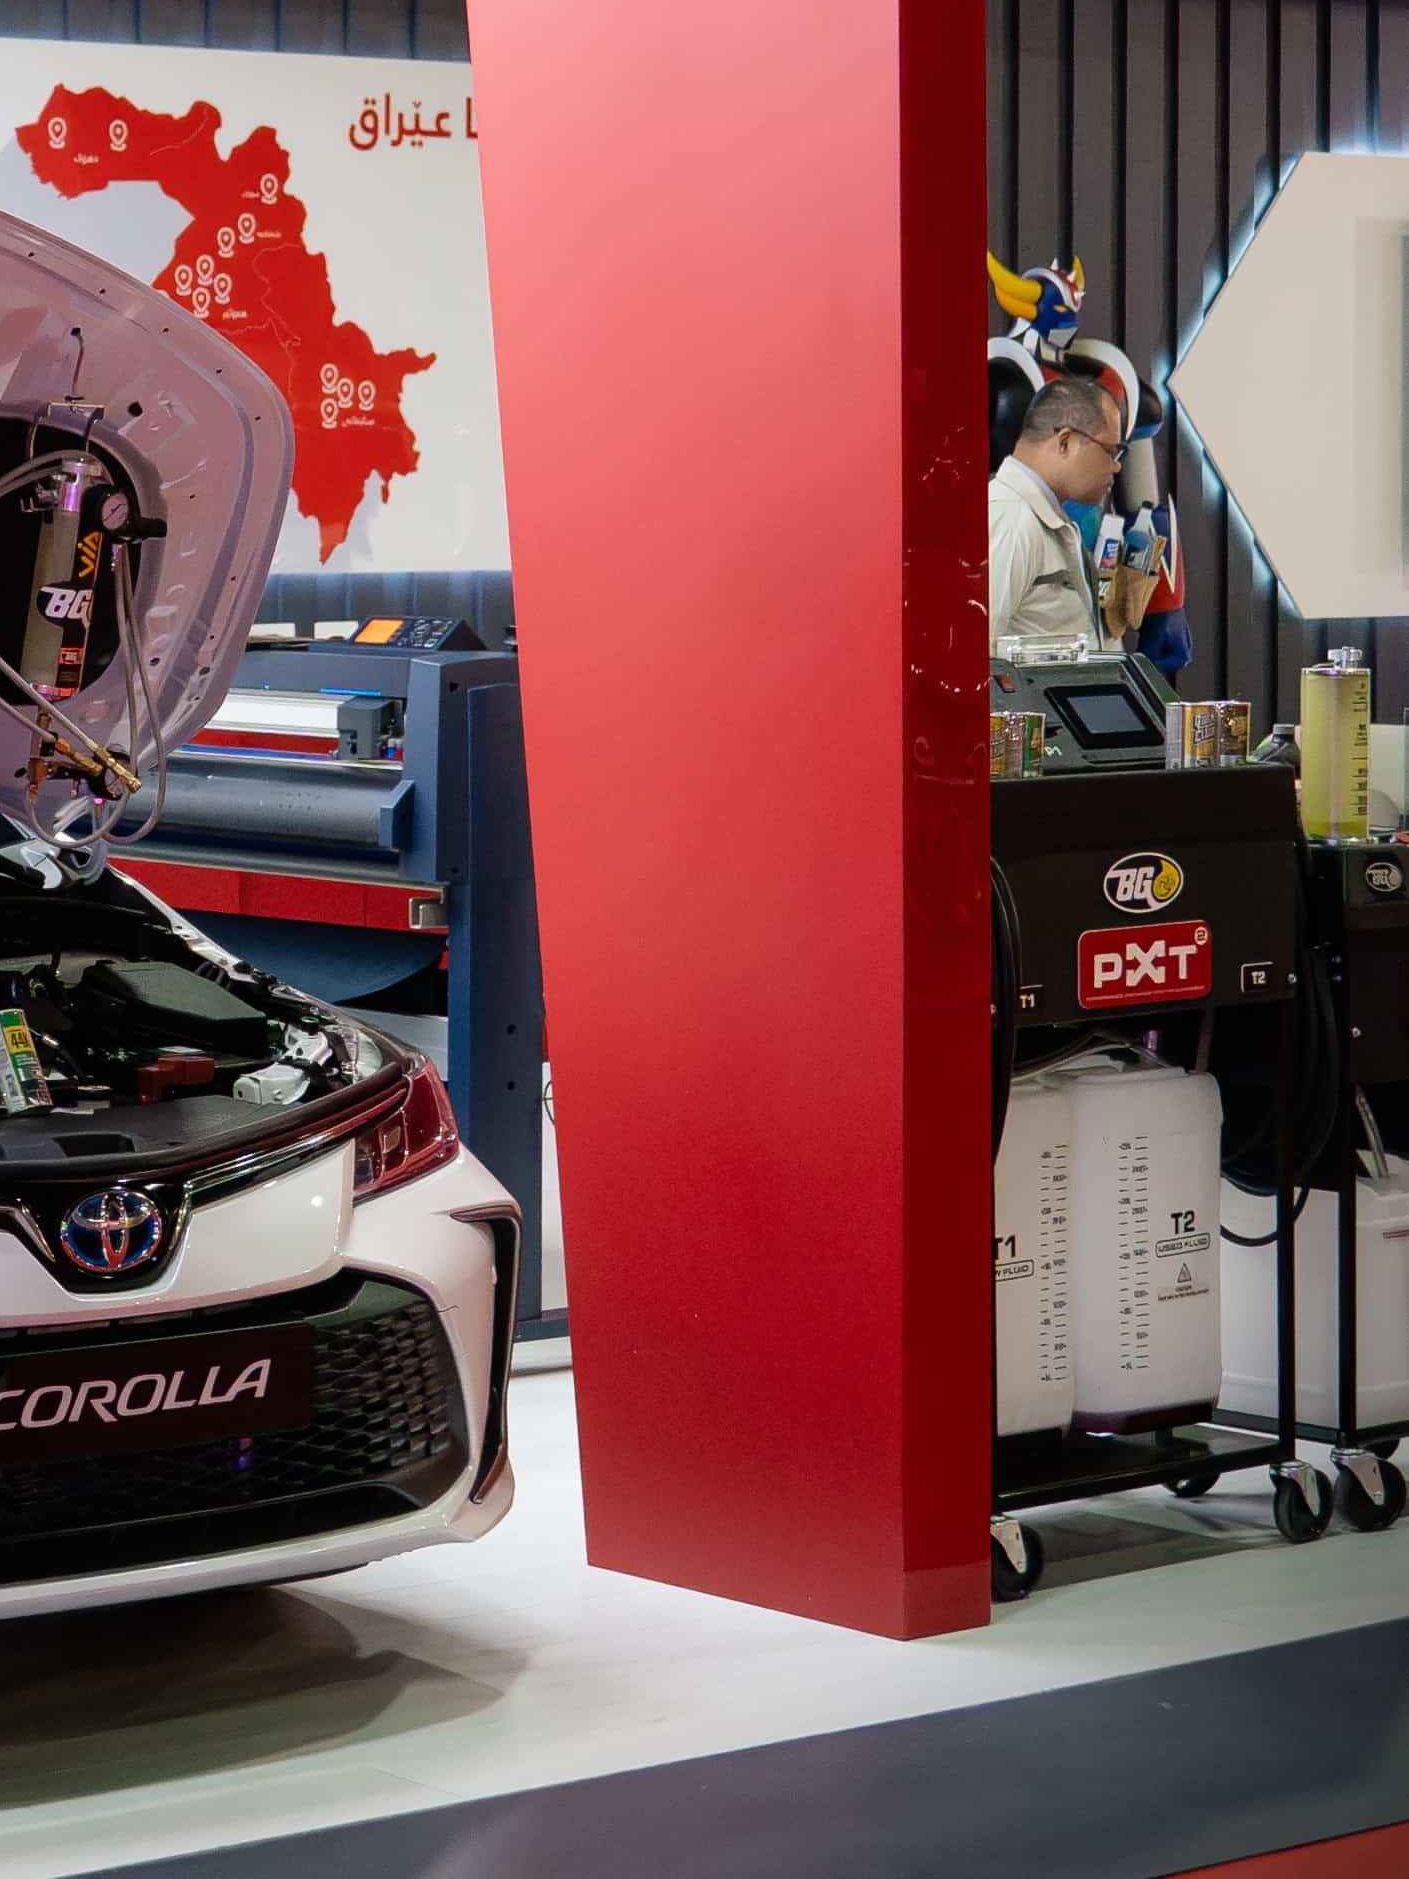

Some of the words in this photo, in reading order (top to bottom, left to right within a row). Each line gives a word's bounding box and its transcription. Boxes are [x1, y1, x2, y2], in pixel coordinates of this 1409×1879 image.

[41, 585, 92, 620] BG
[1108, 866, 1156, 903] BG
[1093, 940, 1198, 989] PXT
[1251, 970, 1267, 985] T2
[1020, 993, 1035, 1009] T1
[1170, 1210, 1195, 1234] T2
